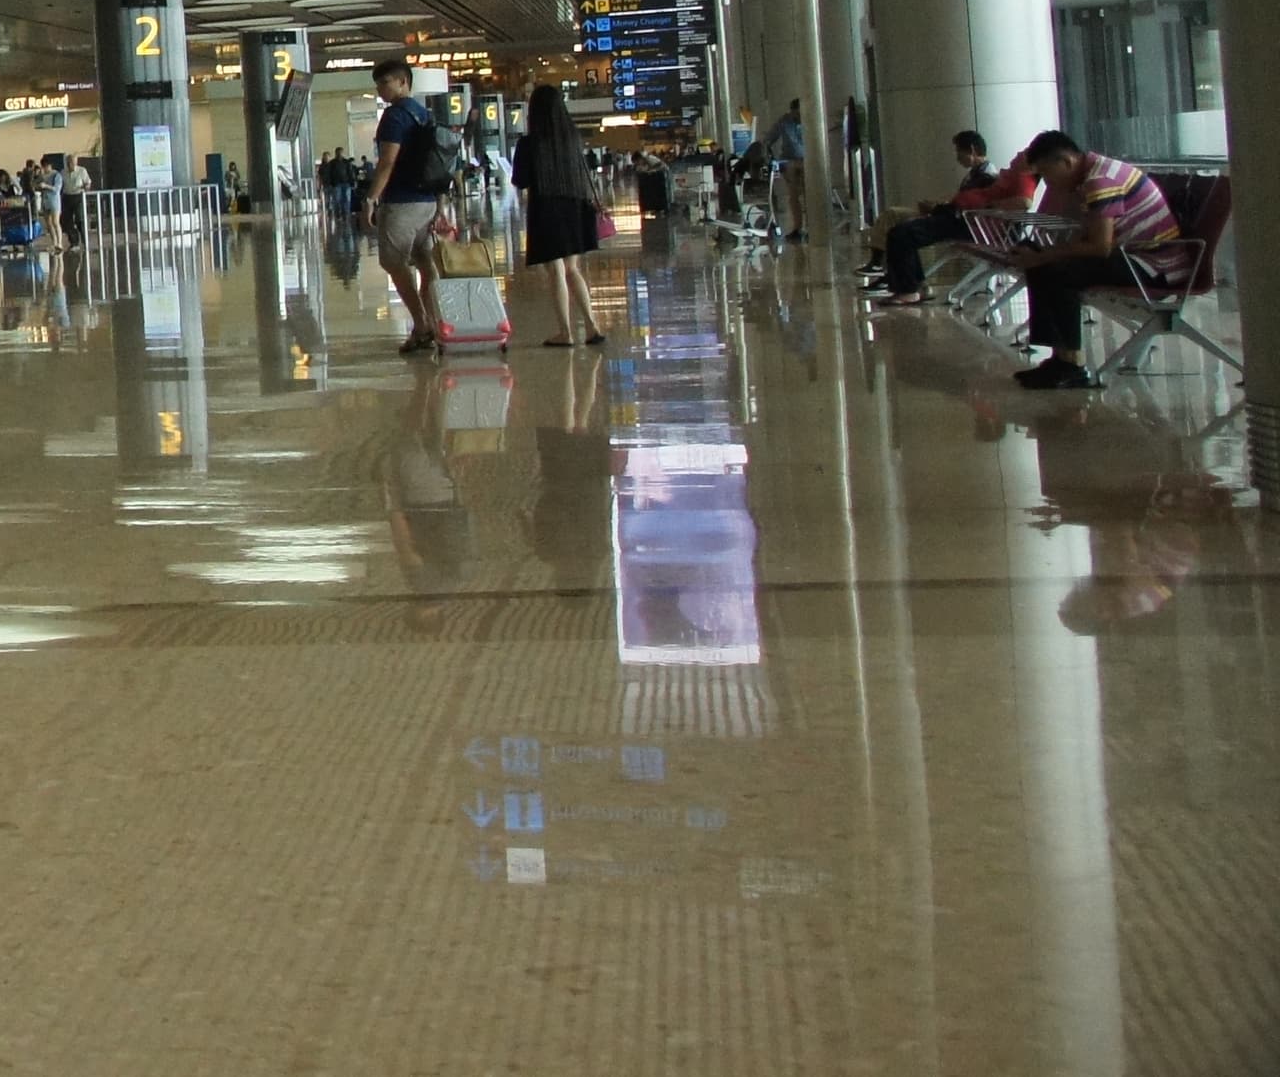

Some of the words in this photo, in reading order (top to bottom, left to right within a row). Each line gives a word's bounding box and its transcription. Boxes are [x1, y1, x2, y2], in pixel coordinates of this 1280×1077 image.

[640, 15, 672, 27] Changer
[135, 16, 161, 57] 2
[273, 50, 292, 81] 3
[5, 96, 27, 110] GST
[28, 93, 69, 108] Refund
[449, 95, 462, 114] 5
[485, 105, 497, 121] 6
[510, 110, 520, 126] 7
